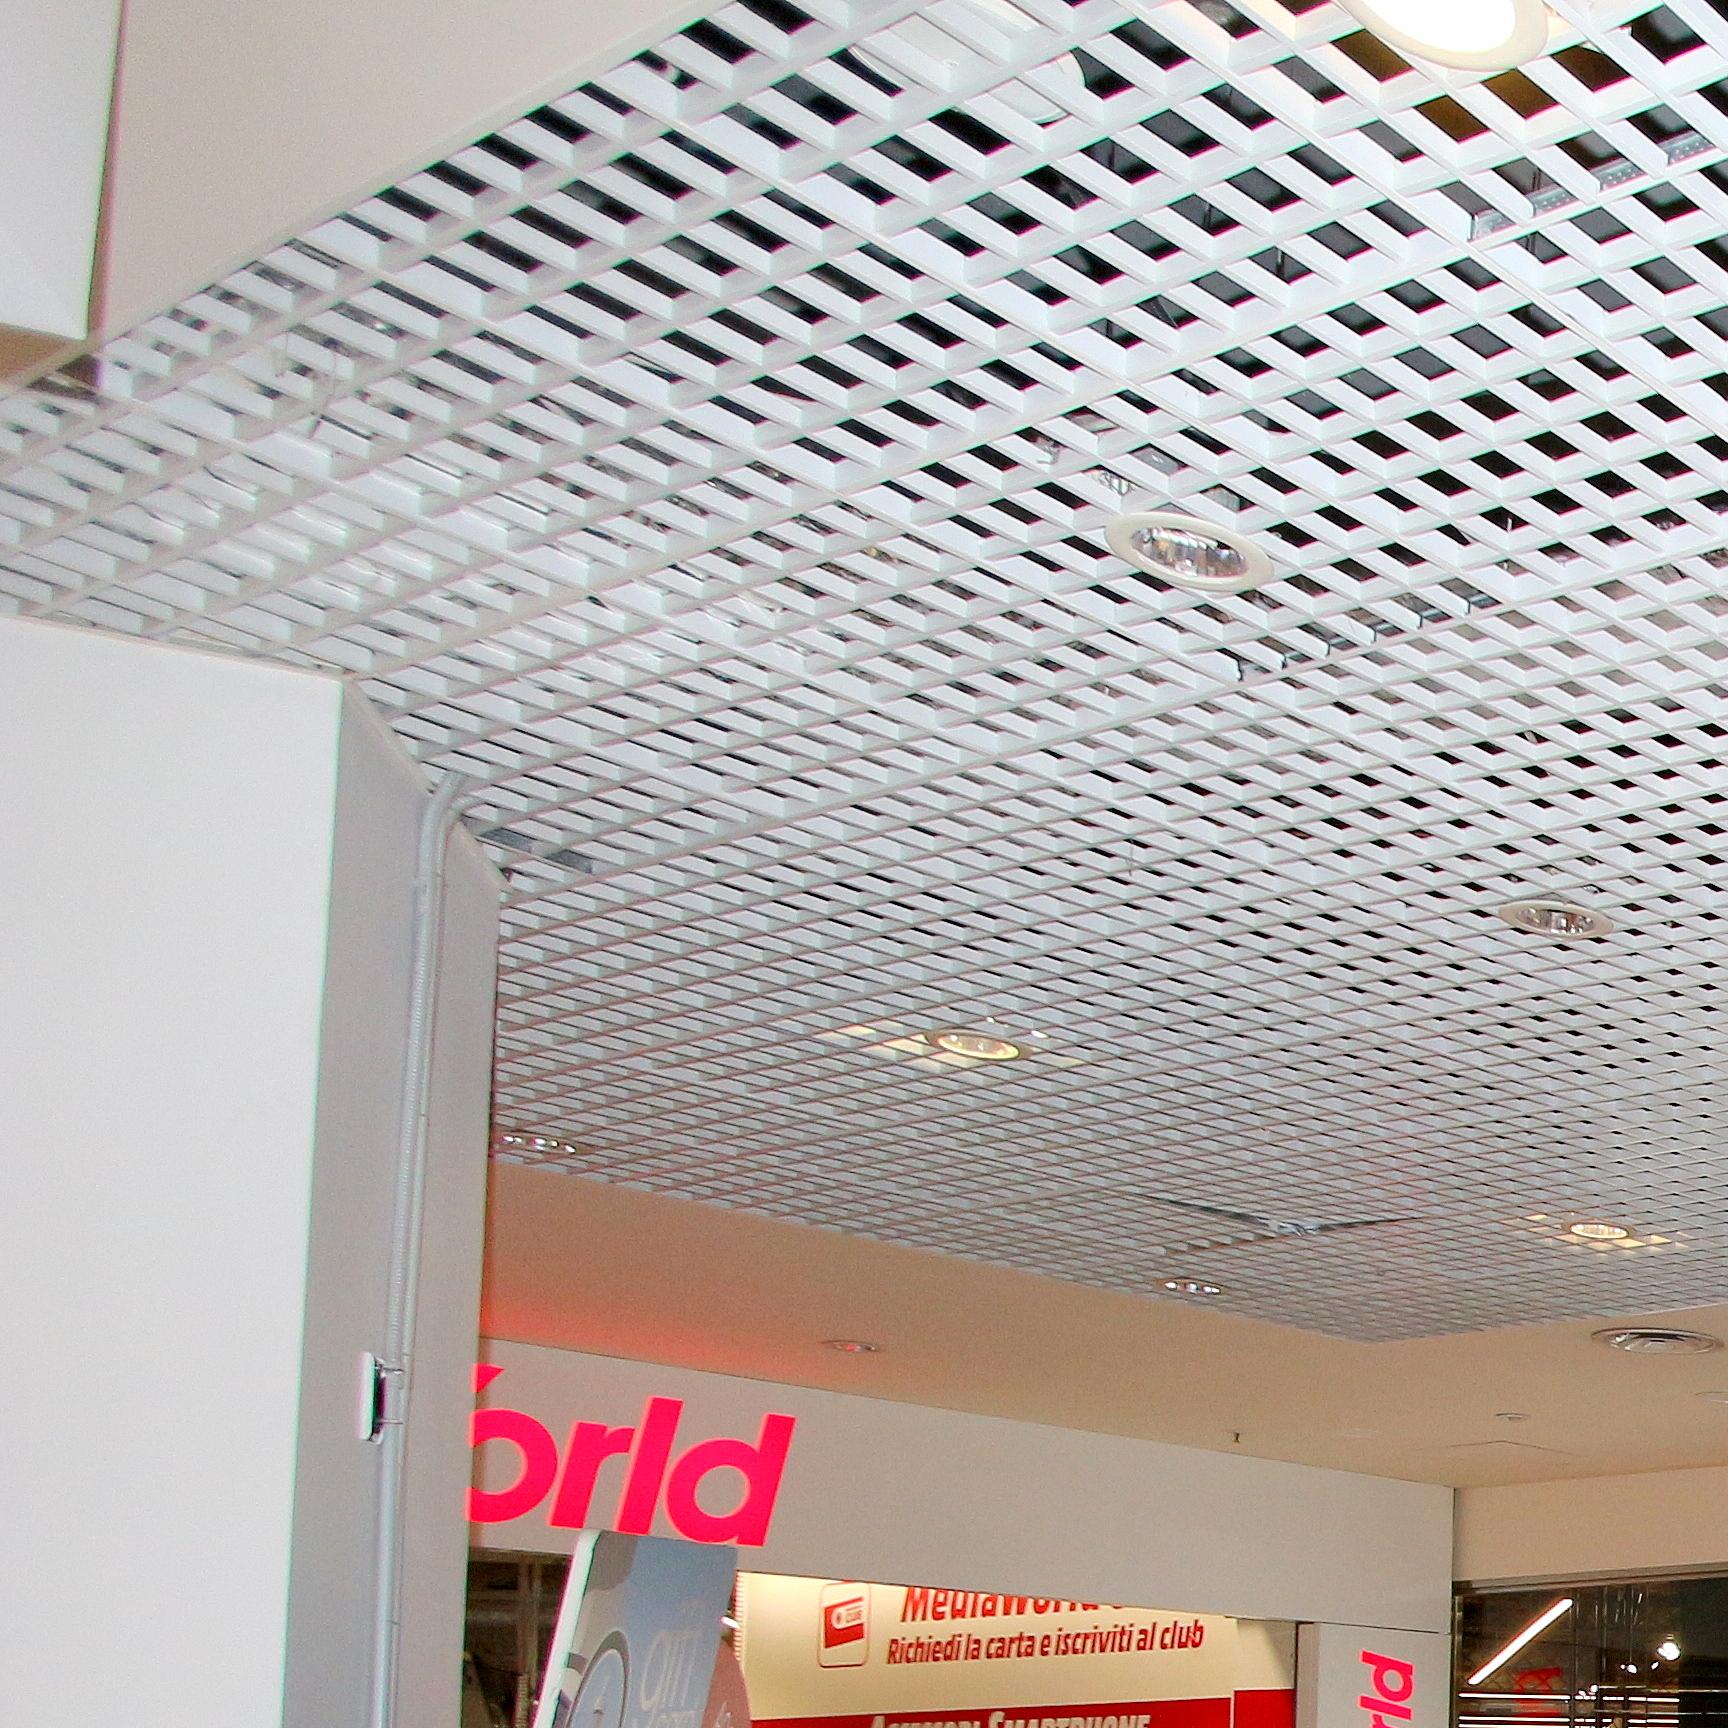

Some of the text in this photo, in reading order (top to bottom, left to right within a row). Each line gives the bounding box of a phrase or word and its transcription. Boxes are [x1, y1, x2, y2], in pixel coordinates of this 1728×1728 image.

[466, 1363, 797, 1548] orld
[887, 1619, 1204, 1664] Richiedi la carta e iscriviti al club
